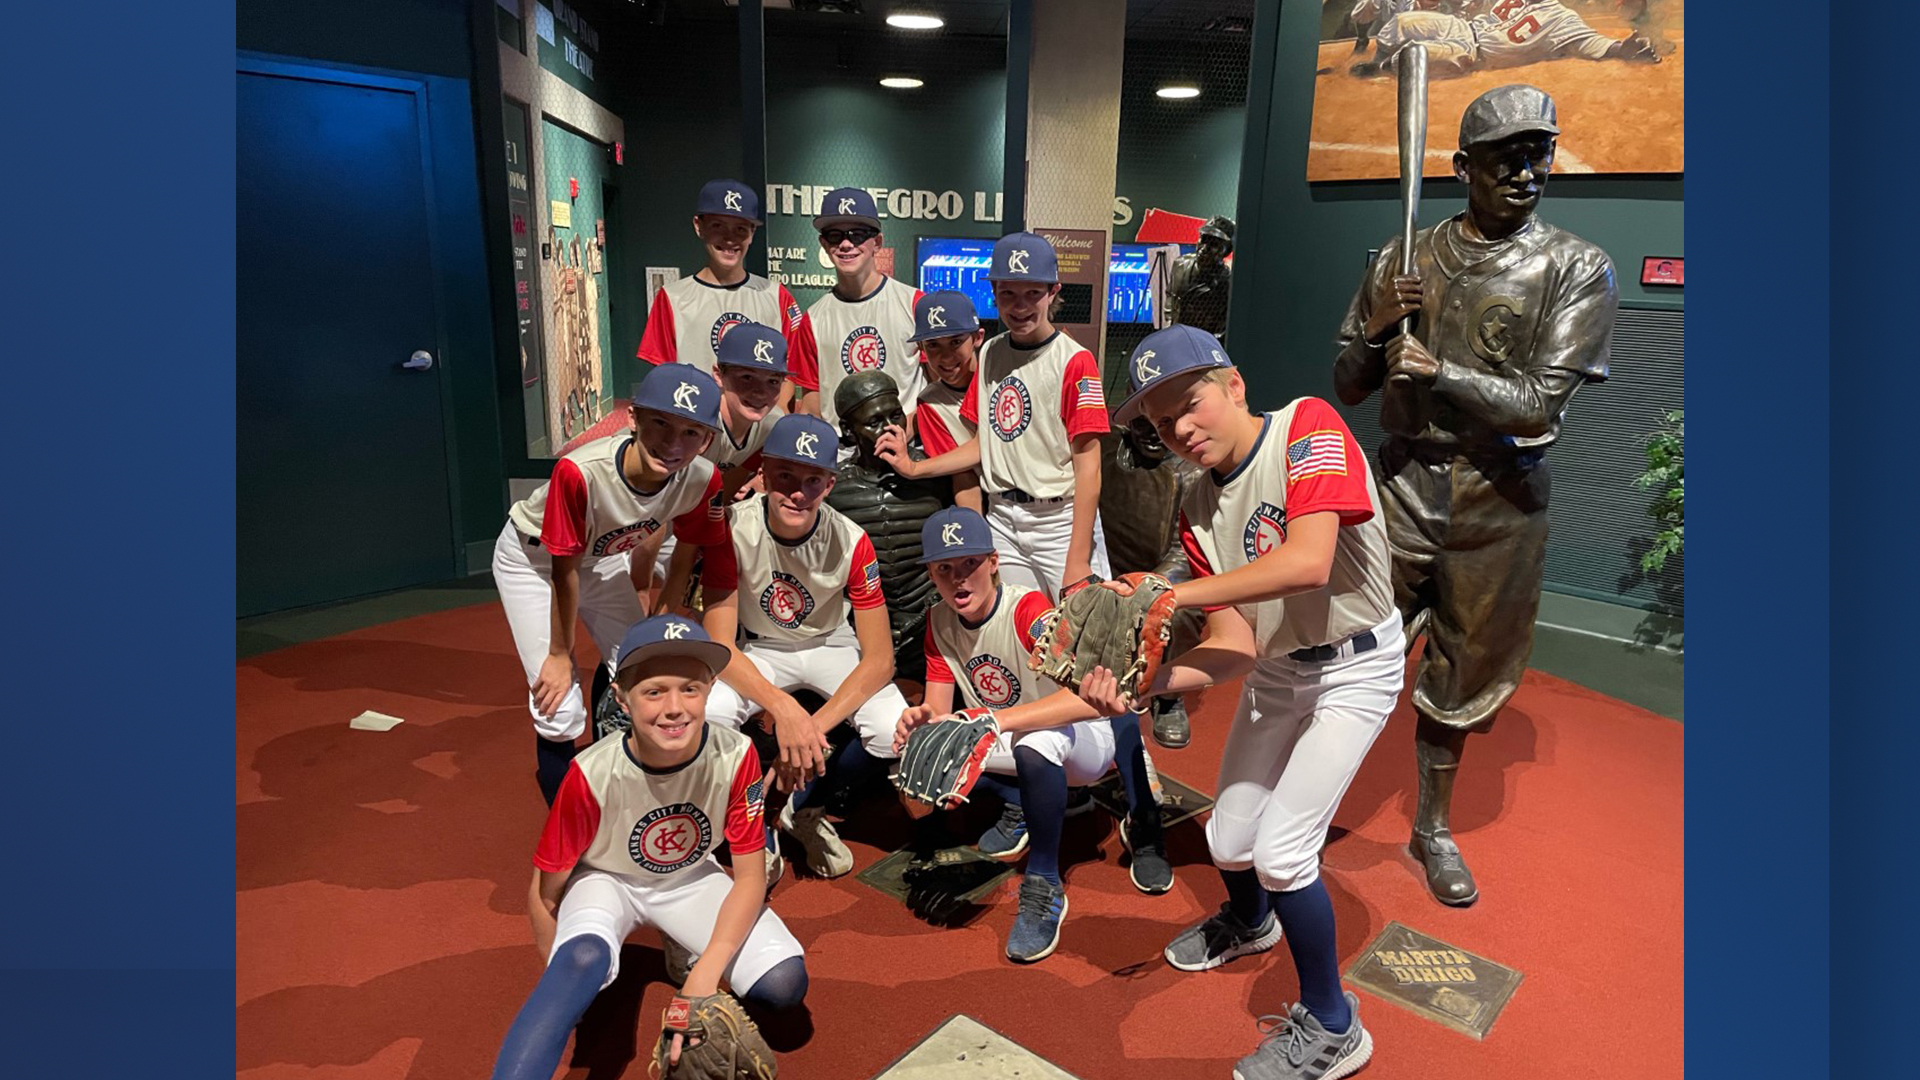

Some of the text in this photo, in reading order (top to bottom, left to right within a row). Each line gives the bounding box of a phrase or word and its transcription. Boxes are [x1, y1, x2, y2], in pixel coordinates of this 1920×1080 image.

[724, 190, 742, 212] KC
[766, 184, 833, 216] THE
[868, 187, 964, 221] EGRO
[786, 247, 807, 260] ARE
[1043, 234, 1094, 249] Welcome
[1008, 250, 1030, 274] KC
[791, 273, 837, 287] LEAGUES
[927, 305, 947, 328] KC
[753, 339, 774, 365] KC
[1135, 349, 1162, 388] KC
[673, 381, 700, 413] KC
[796, 431, 820, 460] KC
[942, 522, 964, 547] KC
[630, 804, 711, 860] KANSAS CITY MONARCHS
[653, 823, 687, 855] KC
[643, 852, 701, 873] BASEBALL CLUB
[1374, 949, 1472, 967] MARTIN
[1390, 966, 1477, 984] DIHIGO
